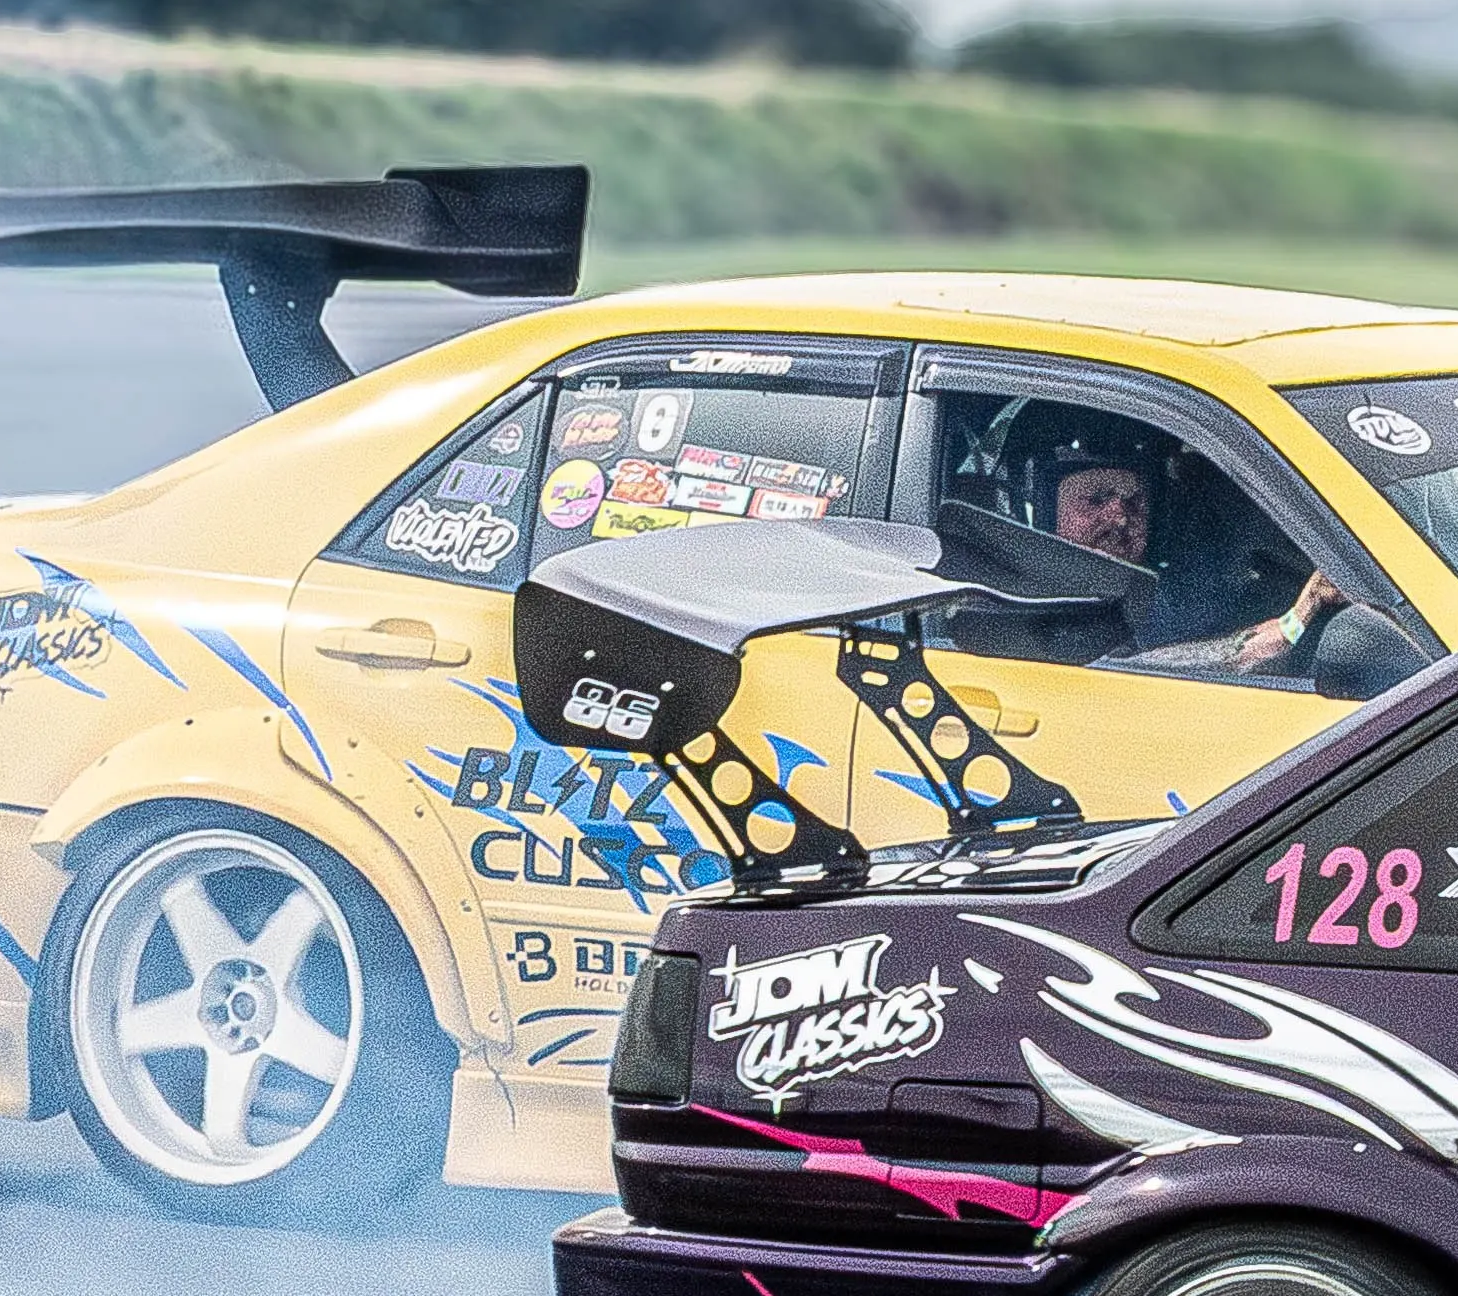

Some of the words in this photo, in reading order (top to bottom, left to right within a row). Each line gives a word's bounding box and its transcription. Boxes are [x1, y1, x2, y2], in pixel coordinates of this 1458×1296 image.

[563, 678, 660, 740] 86
[471, 830, 732, 895] CUSCO
[1265, 842, 1423, 949] 128
[743, 989, 931, 1083] CLASSICS
